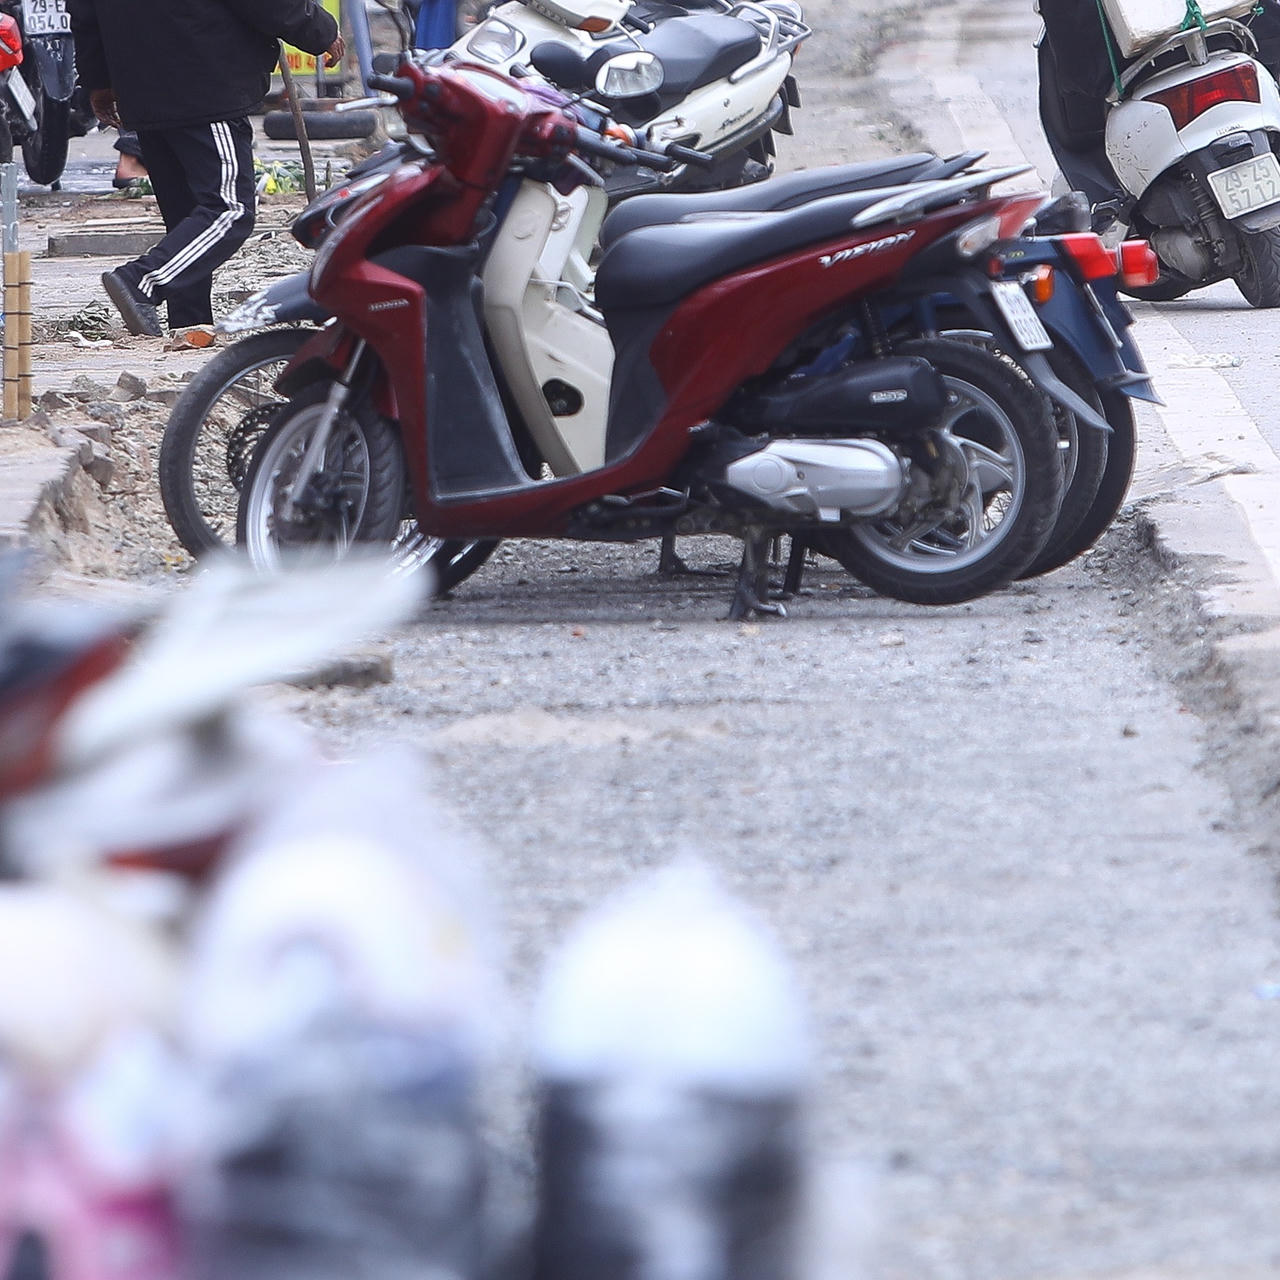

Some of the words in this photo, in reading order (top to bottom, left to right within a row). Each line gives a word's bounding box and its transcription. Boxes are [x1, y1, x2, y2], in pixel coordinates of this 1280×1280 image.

[1221, 160, 1271, 192] 29-Z5
[1228, 180, 1276, 211] 5712
[818, 228, 917, 268] VISION
[368, 298, 410, 312] HONDA
